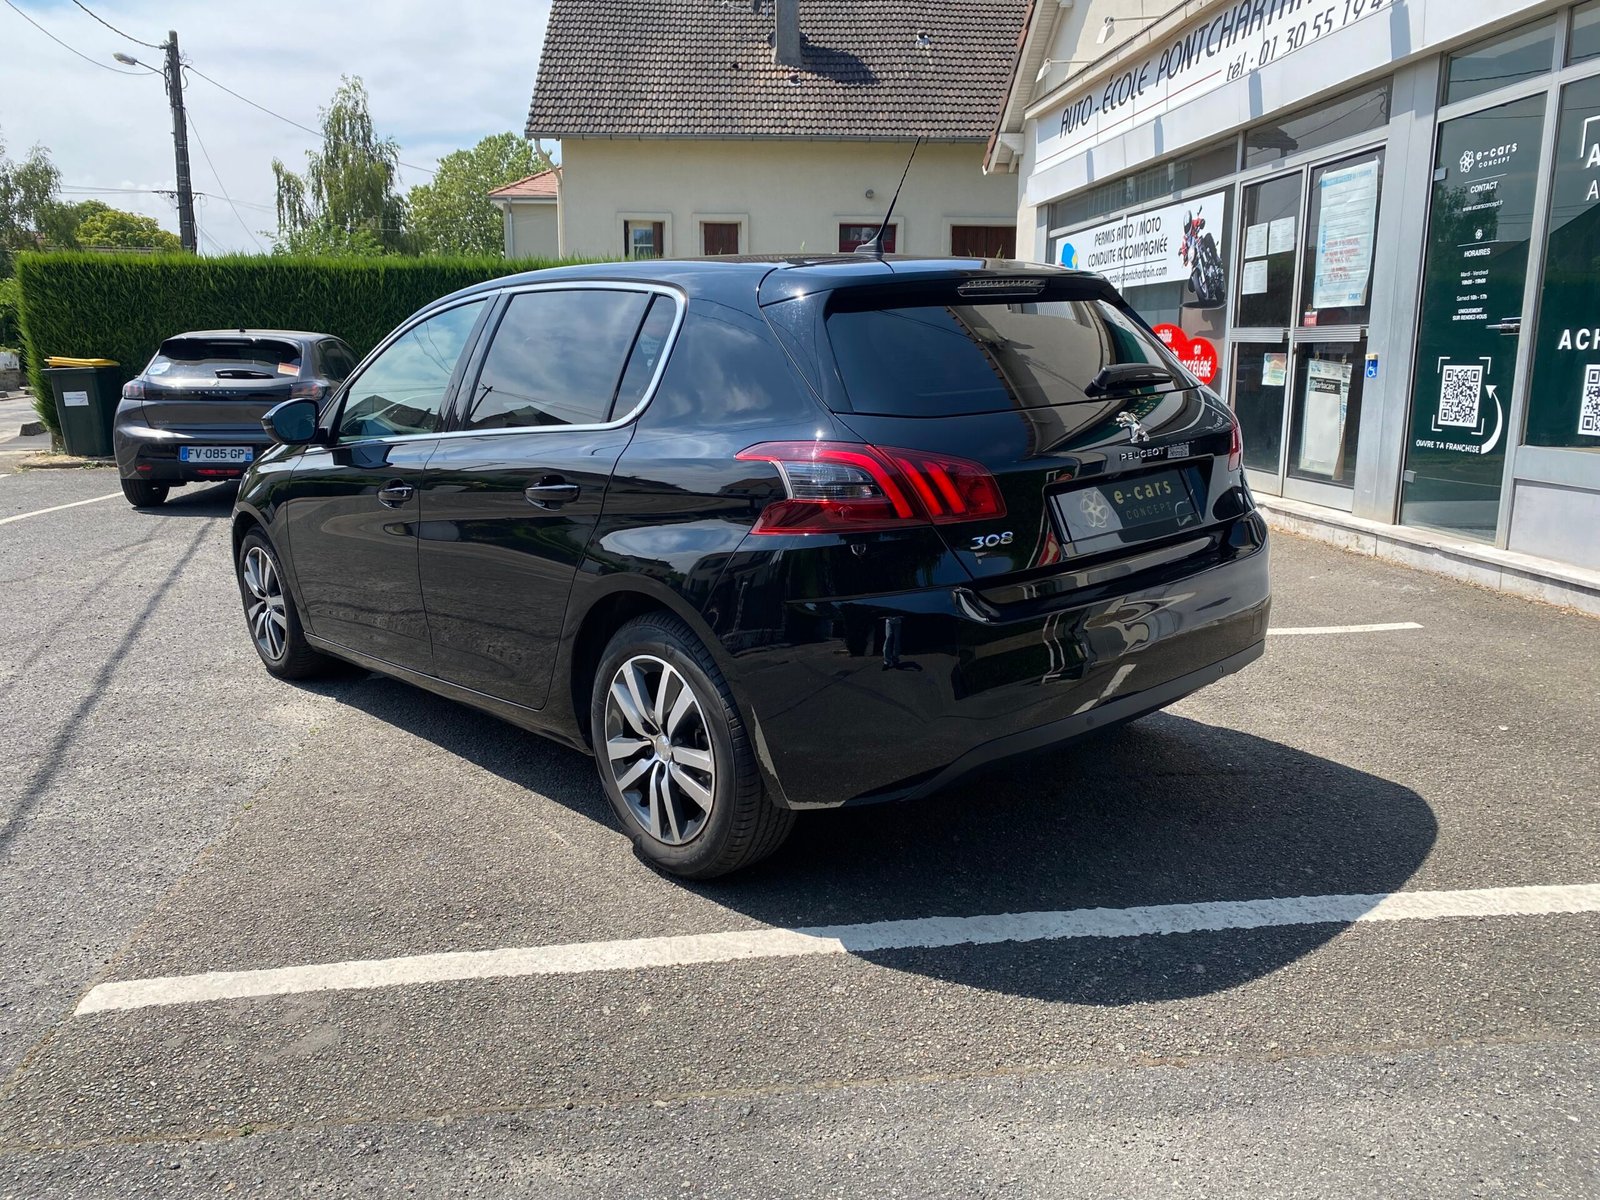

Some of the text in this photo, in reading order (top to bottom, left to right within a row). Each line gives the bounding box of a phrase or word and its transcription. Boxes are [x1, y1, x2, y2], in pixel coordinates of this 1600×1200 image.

[1258, 35, 1278, 66] 01
[1283, 21, 1307, 54] 30
[1312, 6, 1335, 39] 55
[1343, 0, 1365, 25] 19
[1476, 142, 1518, 161] e-cars
[1478, 155, 1510, 169] CONCEPT
[1470, 180, 1498, 194] CONTACT
[1094, 227, 1115, 247] PERMIS
[1140, 216, 1162, 237] MOTO
[1087, 234, 1168, 268] CONDUITE ACCOMPAGNÉE
[1464, 247, 1491, 258] HORAIRES
[1120, 446, 1165, 461] PEUGEOT
[1415, 439, 1481, 454] OUVRE TA FRANCHISE
[1113, 480, 1172, 505] e-cars
[1126, 501, 1172, 520] CONCEPT
[970, 531, 1013, 550] 308
